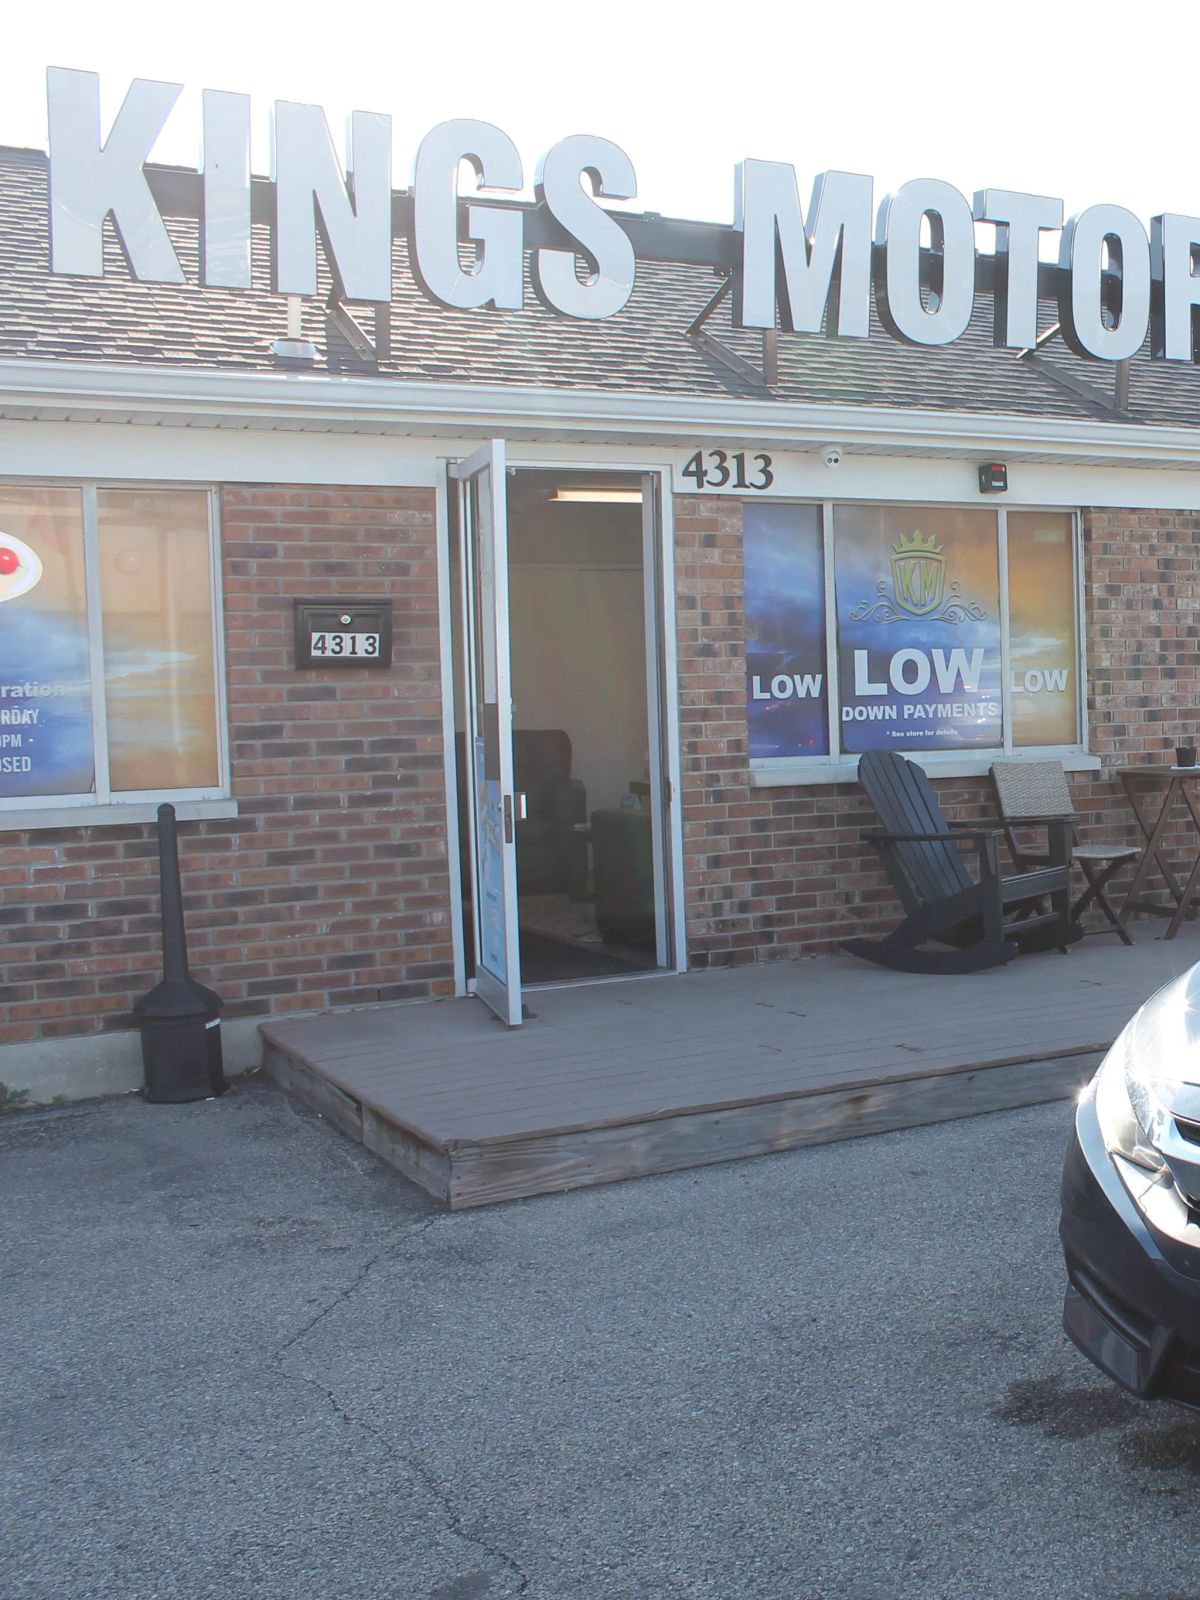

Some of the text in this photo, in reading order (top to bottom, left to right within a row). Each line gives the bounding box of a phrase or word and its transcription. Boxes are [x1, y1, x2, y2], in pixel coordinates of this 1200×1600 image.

[46, 65, 638, 320] KINGS
[682, 449, 774, 490] 4313
[899, 560, 939, 607] KM
[313, 634, 377, 655] 4313
[852, 648, 985, 696] LOW
[1010, 669, 1069, 693] LOW
[752, 673, 823, 700] LOW
[841, 702, 998, 722] DOWN PAYMENTS
[0, 734, 22, 748] PM
[0, 756, 31, 773] SED
